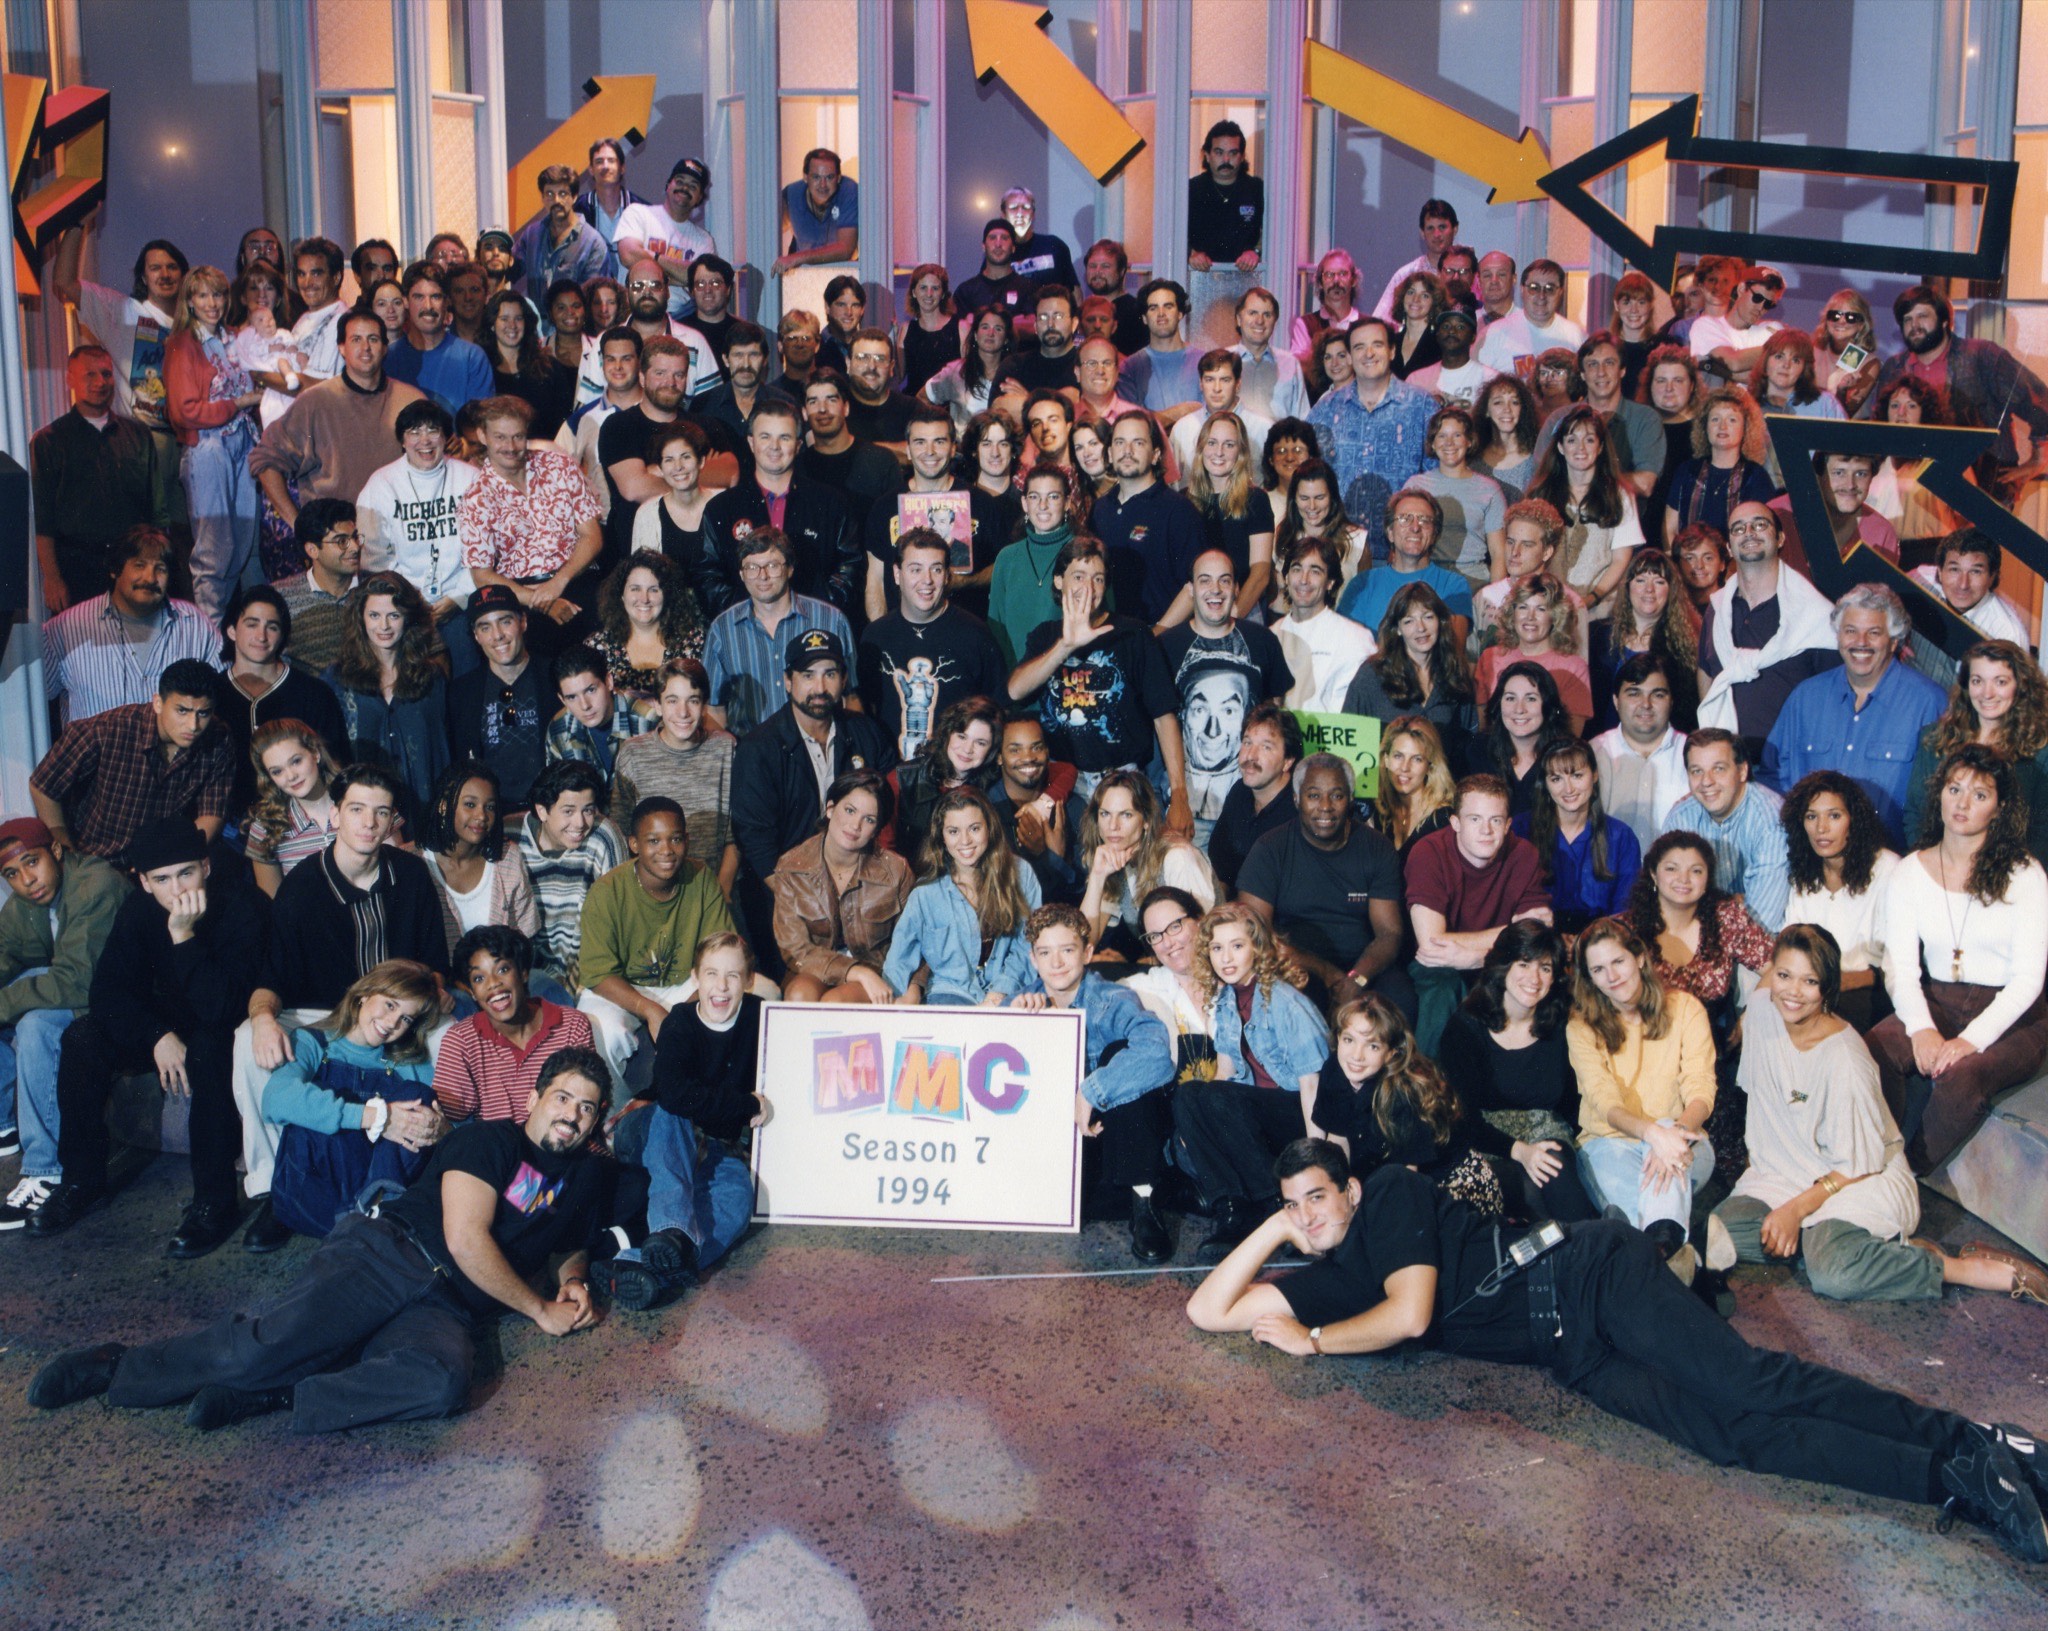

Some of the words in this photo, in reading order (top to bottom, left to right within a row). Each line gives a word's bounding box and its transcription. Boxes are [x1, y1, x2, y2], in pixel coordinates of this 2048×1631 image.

[393, 494, 462, 520] MICHIGA
[407, 517, 457, 541] STATE
[1301, 724, 1357, 747] WHERE
[813, 1033, 1031, 1121] MMC
[842, 1132, 957, 1164] Season
[974, 1136, 991, 1165] 7
[876, 1176, 952, 1206] 1994
